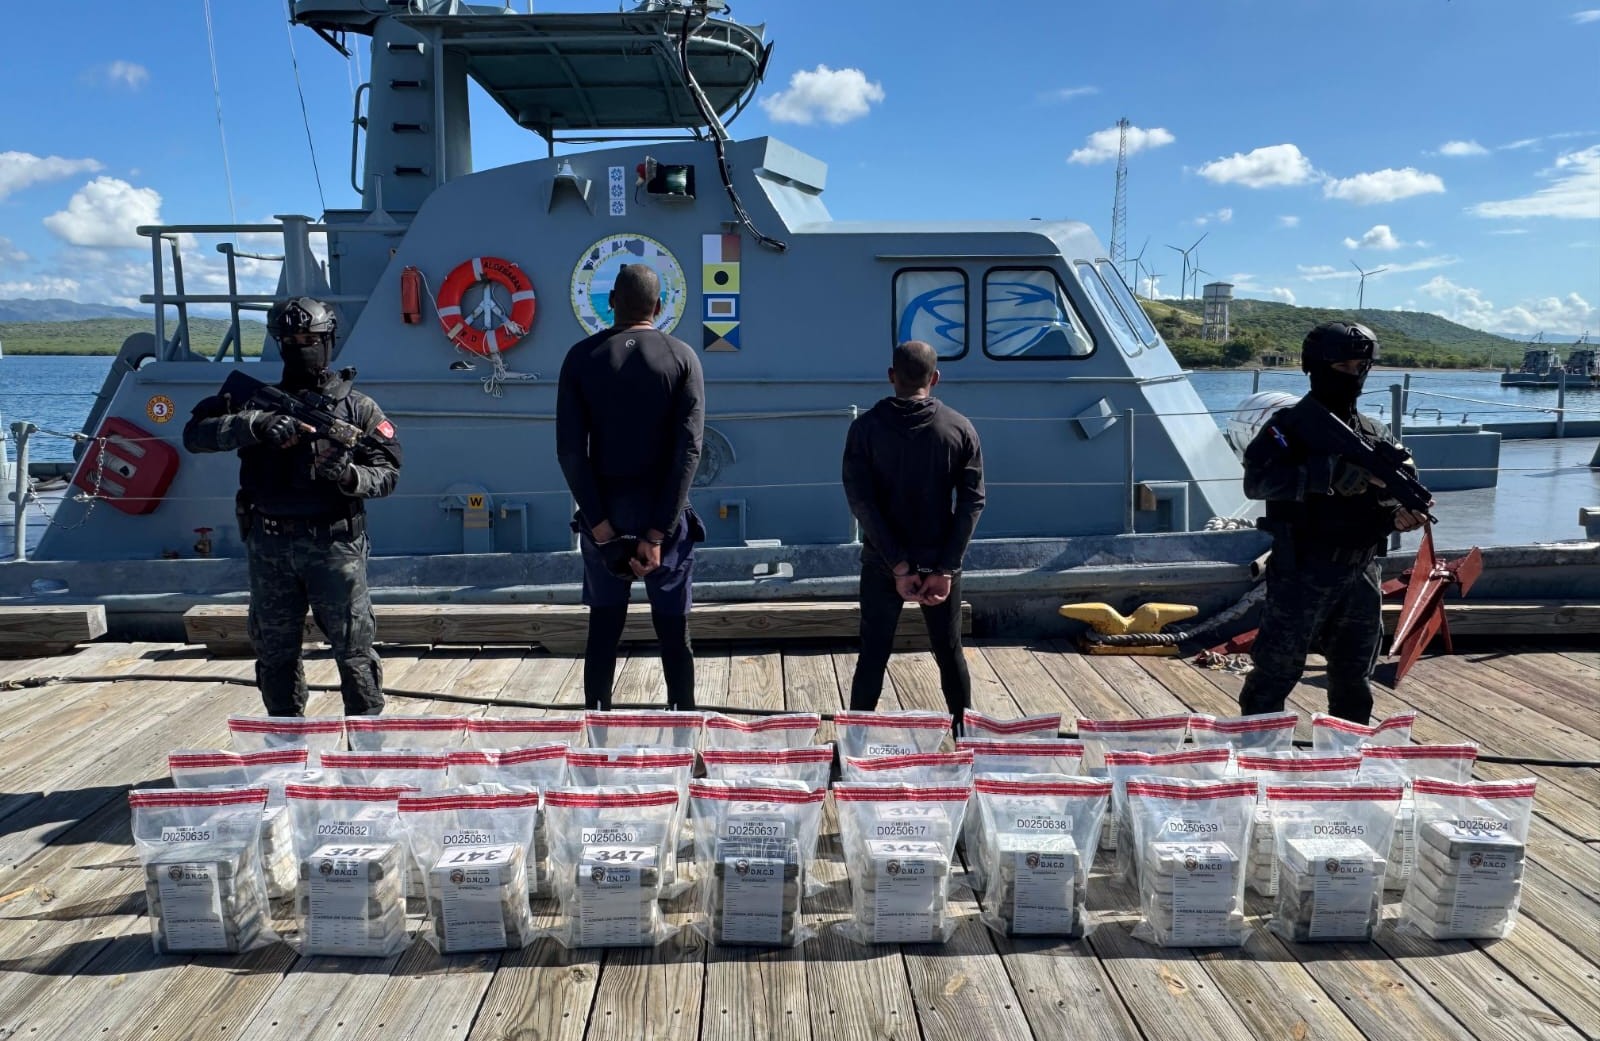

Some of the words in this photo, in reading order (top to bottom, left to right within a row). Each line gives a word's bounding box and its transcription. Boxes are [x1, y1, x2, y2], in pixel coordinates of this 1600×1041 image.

[155, 403, 164, 415] 3
[470, 496, 482, 507] W
[741, 803, 785, 812] 347
[889, 806, 934, 816] 347
[318, 824, 368, 836] D0250632
[1016, 819, 1067, 830] D0250638
[1169, 822, 1218, 833] D0250639
[1313, 825, 1365, 835] D0250645
[1459, 820, 1509, 831] D0250624
[162, 830, 210, 842] D0250635
[728, 825, 779, 836] D0250637
[877, 825, 927, 836] D0250617
[583, 832, 634, 843] D0250630
[324, 847, 378, 857] 347
[881, 843, 927, 853] 347
[449, 849, 502, 864] 347
[594, 850, 645, 861] 347
